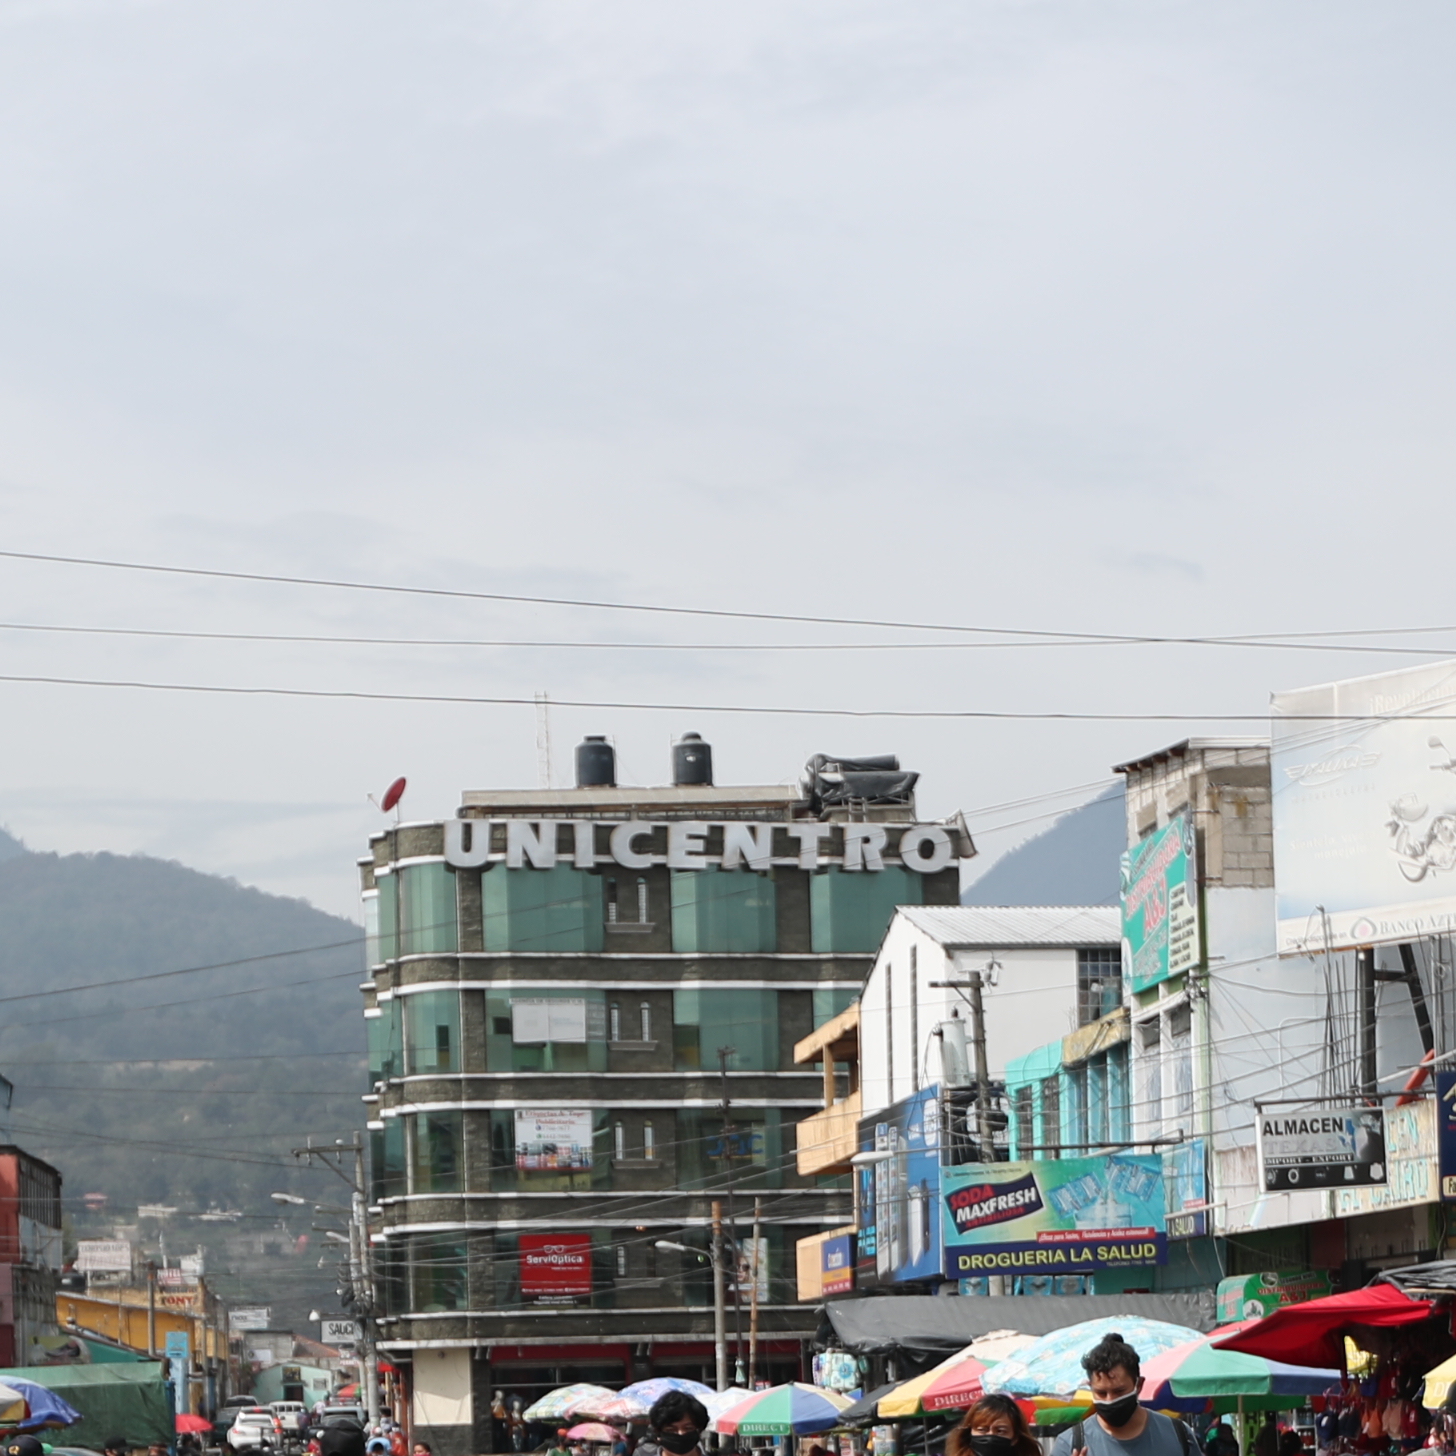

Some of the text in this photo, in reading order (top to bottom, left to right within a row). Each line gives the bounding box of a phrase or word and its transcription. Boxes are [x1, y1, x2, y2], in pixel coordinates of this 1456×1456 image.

[445, 819, 956, 874] UNICENTRO
[1379, 915, 1425, 936] BANCO
[1263, 1117, 1344, 1137] ALMACEN
[950, 1184, 995, 1209] SODA
[955, 1186, 1037, 1224] MAXFRESH
[958, 1242, 1157, 1271] DROGUERIA LA SALUD
[742, 1423, 786, 1433] DIRECT
